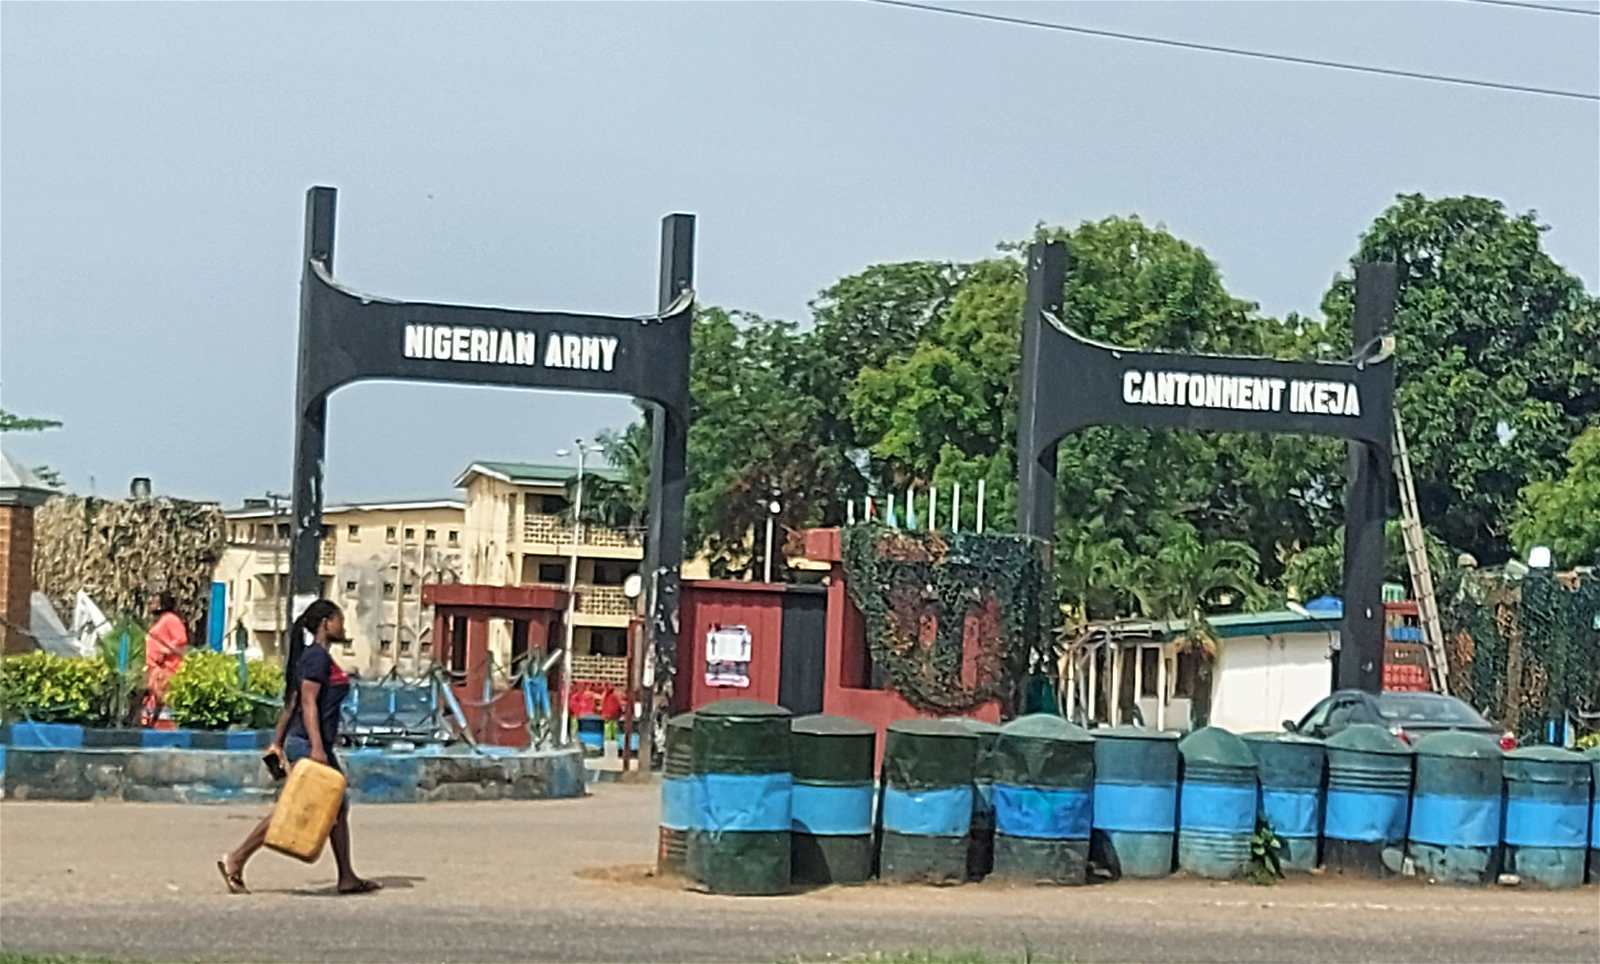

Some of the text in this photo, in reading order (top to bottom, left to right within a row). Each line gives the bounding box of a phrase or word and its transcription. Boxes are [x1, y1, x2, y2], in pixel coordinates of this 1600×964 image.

[404, 325, 618, 371] NIGERIAN ARMY
[1122, 370, 1361, 416] CANTONMENT IKEJA
